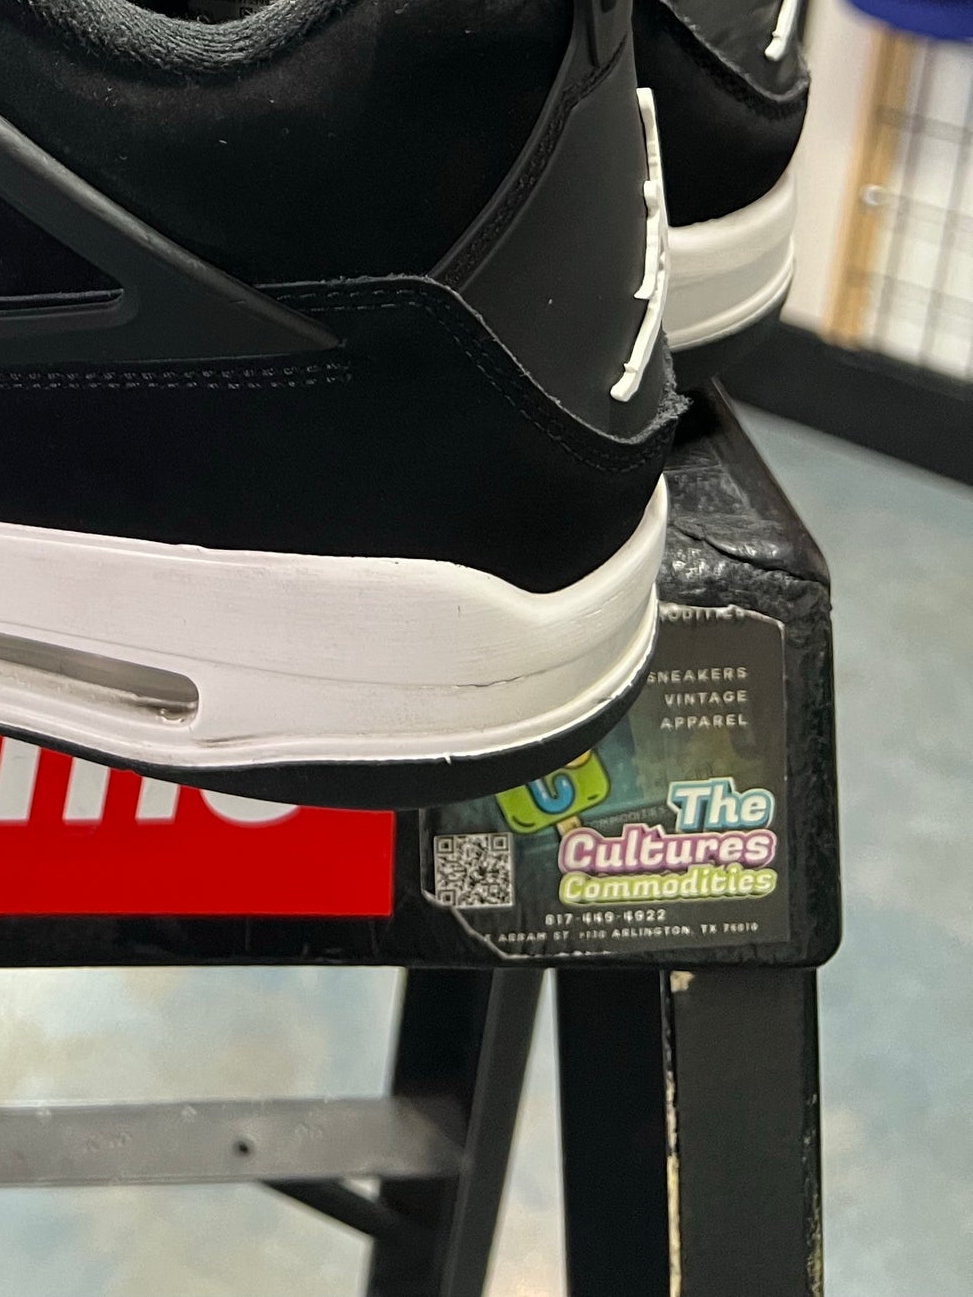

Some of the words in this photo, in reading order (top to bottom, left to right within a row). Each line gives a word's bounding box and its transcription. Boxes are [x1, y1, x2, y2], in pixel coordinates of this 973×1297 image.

[647, 666, 748, 684] SNEAKERS
[664, 689, 748, 708] VINTAGE
[659, 713, 749, 731] APPAREL
[672, 781, 771, 828] The
[561, 827, 773, 871] Cultures
[561, 868, 775, 903] Commodities
[700, 923, 718, 935] TX
